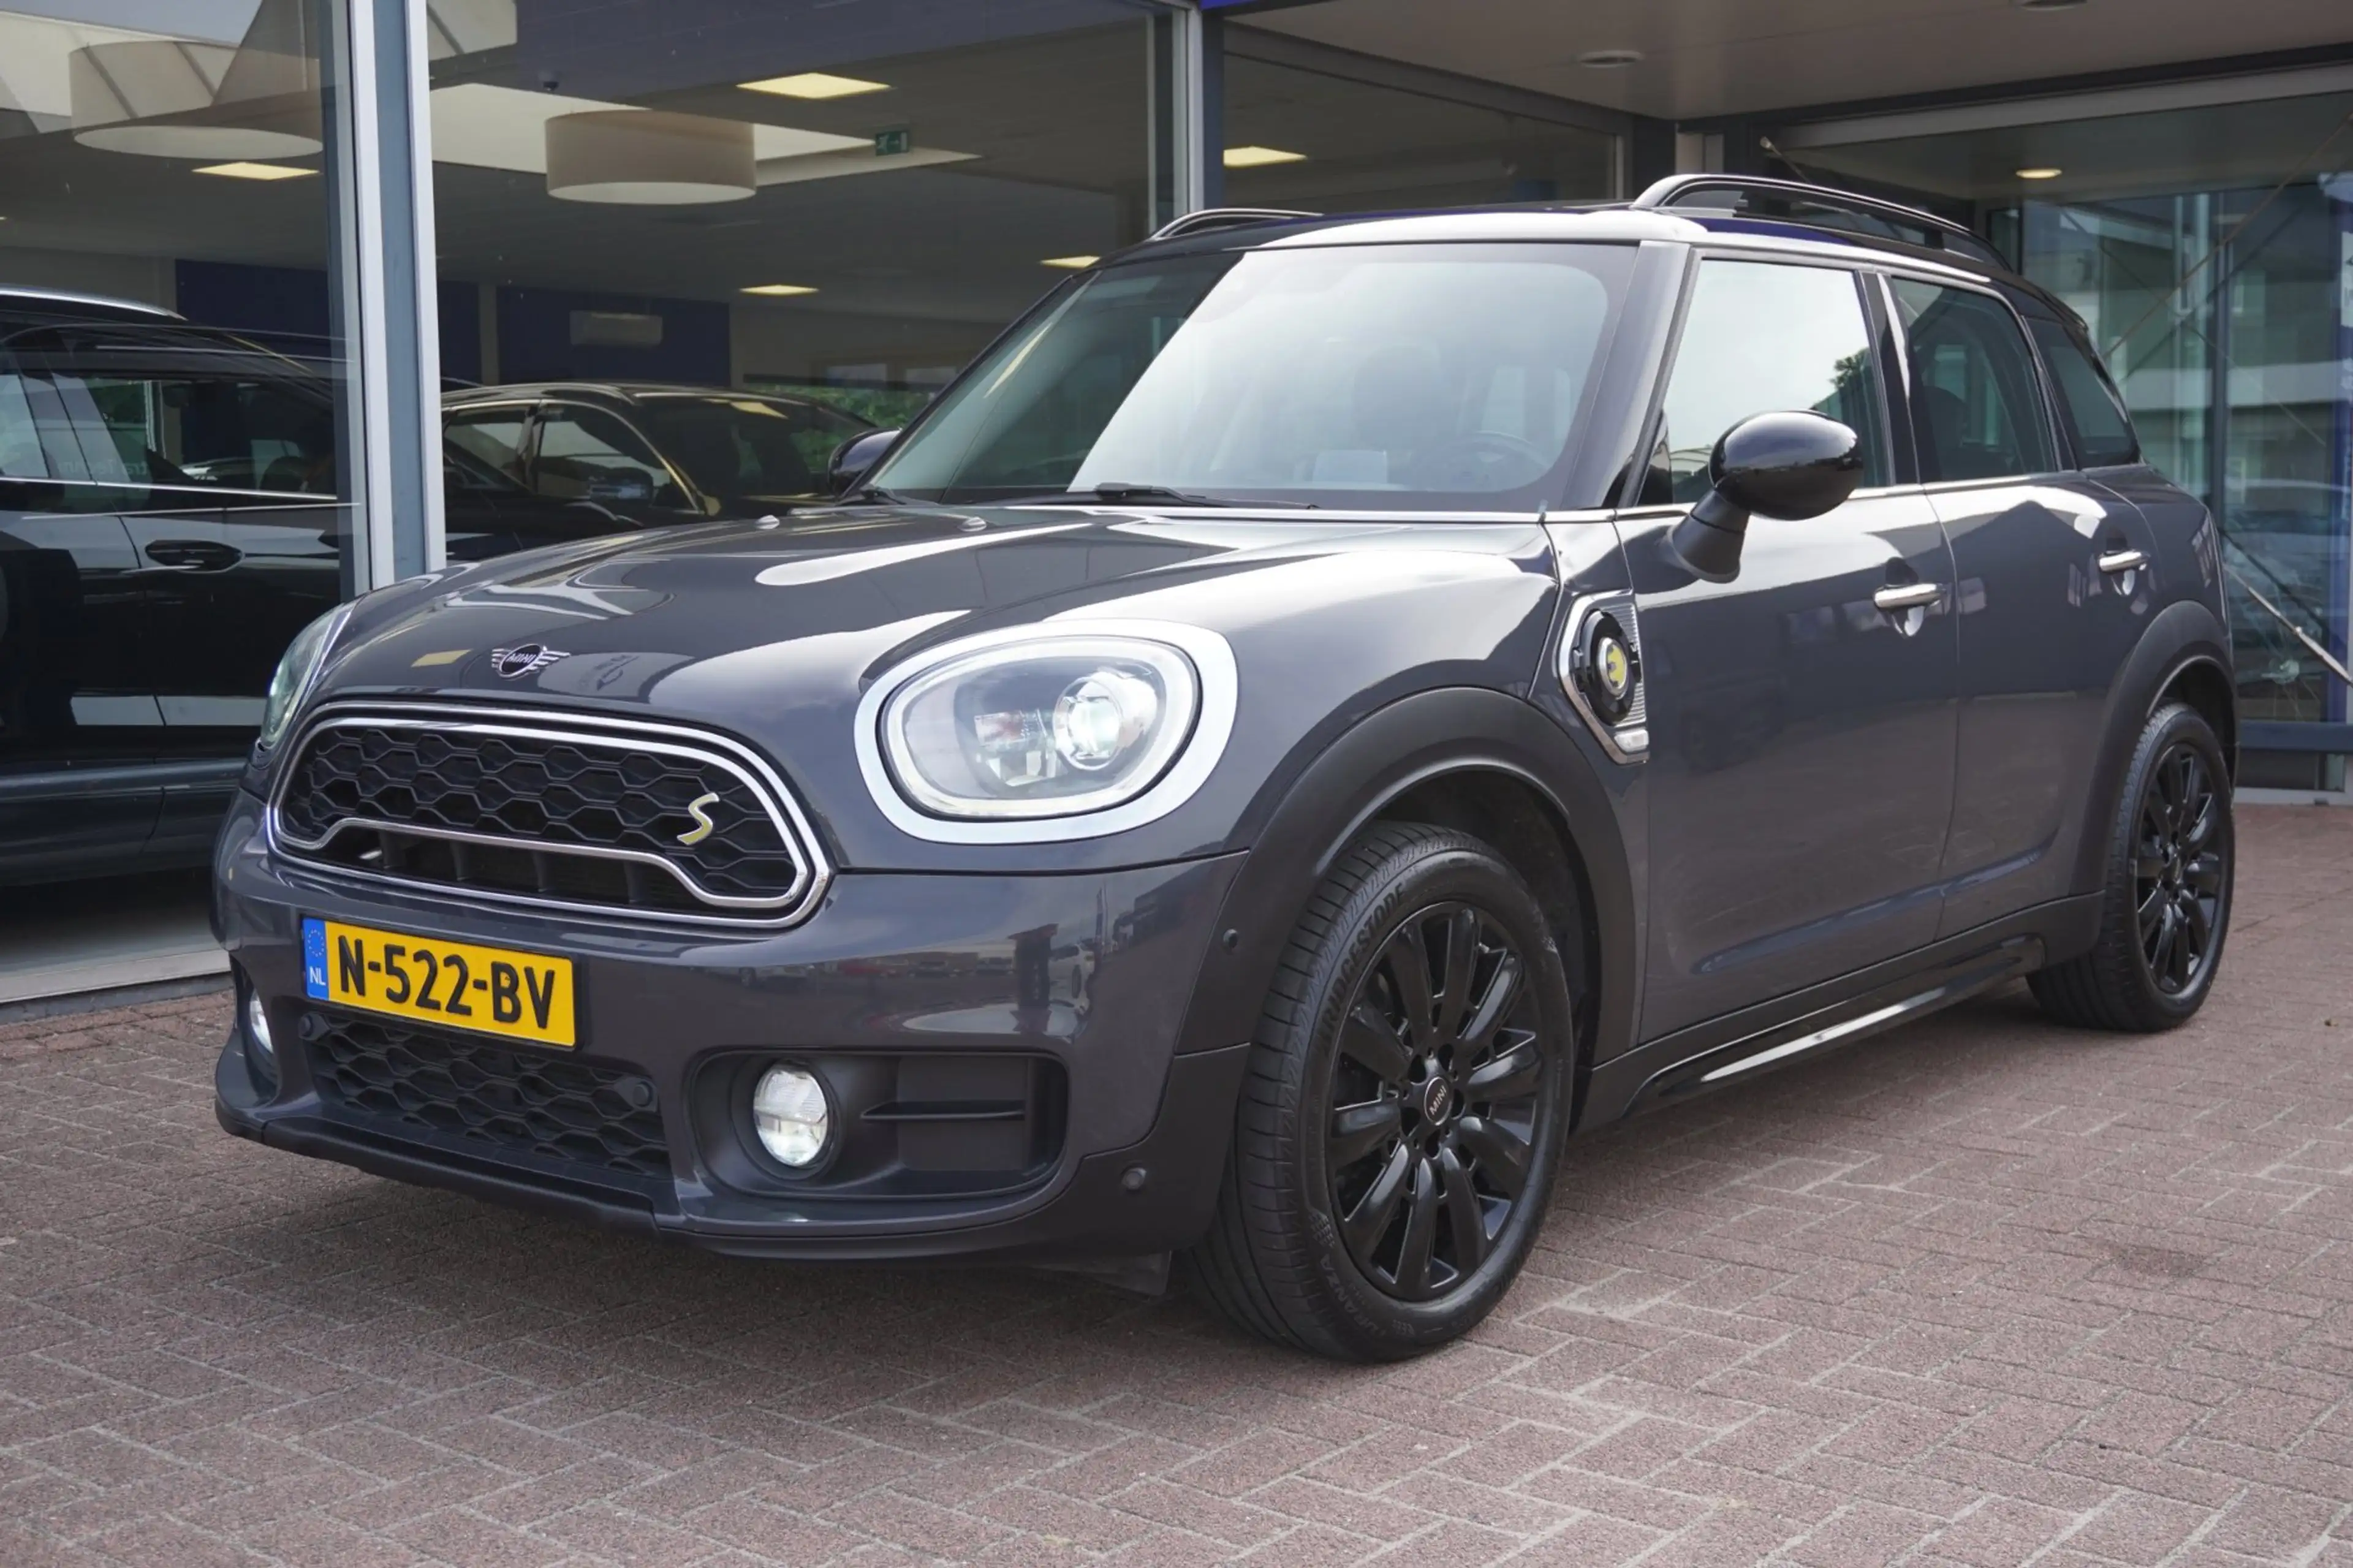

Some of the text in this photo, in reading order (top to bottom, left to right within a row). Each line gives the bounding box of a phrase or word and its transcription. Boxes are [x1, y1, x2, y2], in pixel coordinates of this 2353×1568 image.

[506, 653, 537, 664] MINI
[676, 792, 720, 846] S
[309, 966, 326, 986] NL
[337, 934, 556, 1029] N-522-BV
[1429, 1085, 1446, 1115] MINI
